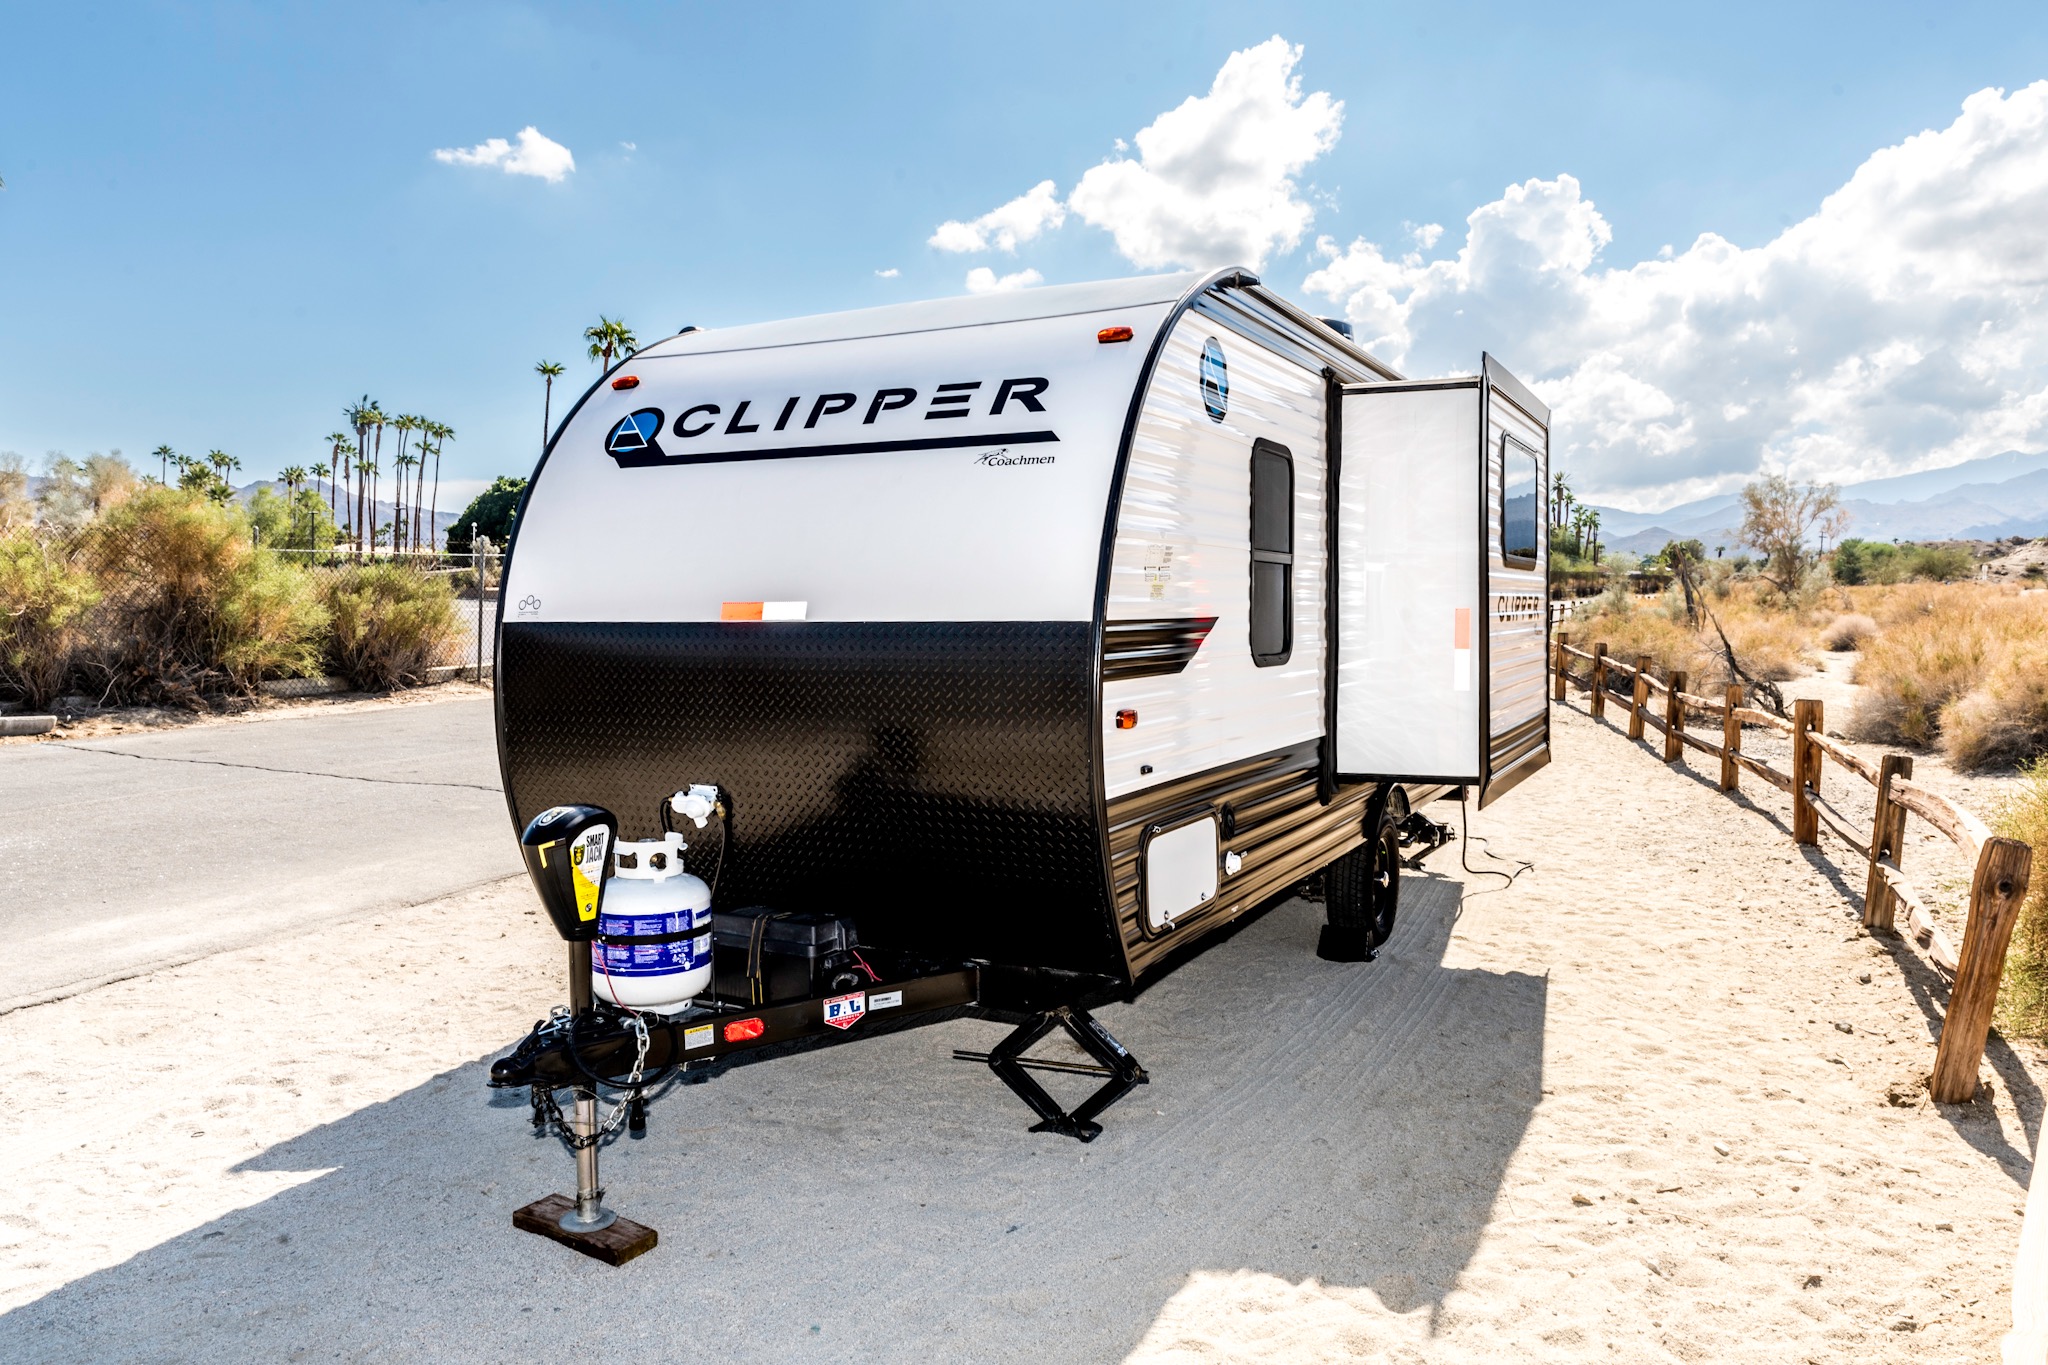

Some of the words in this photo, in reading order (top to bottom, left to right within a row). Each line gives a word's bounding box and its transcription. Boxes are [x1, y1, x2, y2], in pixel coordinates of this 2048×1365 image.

[673, 377, 1050, 438] CLIPPER
[988, 455, 1055, 467] Coachmen
[1497, 595, 1540, 622] CLIPPER
[586, 832, 605, 848] SMART
[586, 845, 603, 864] JACK
